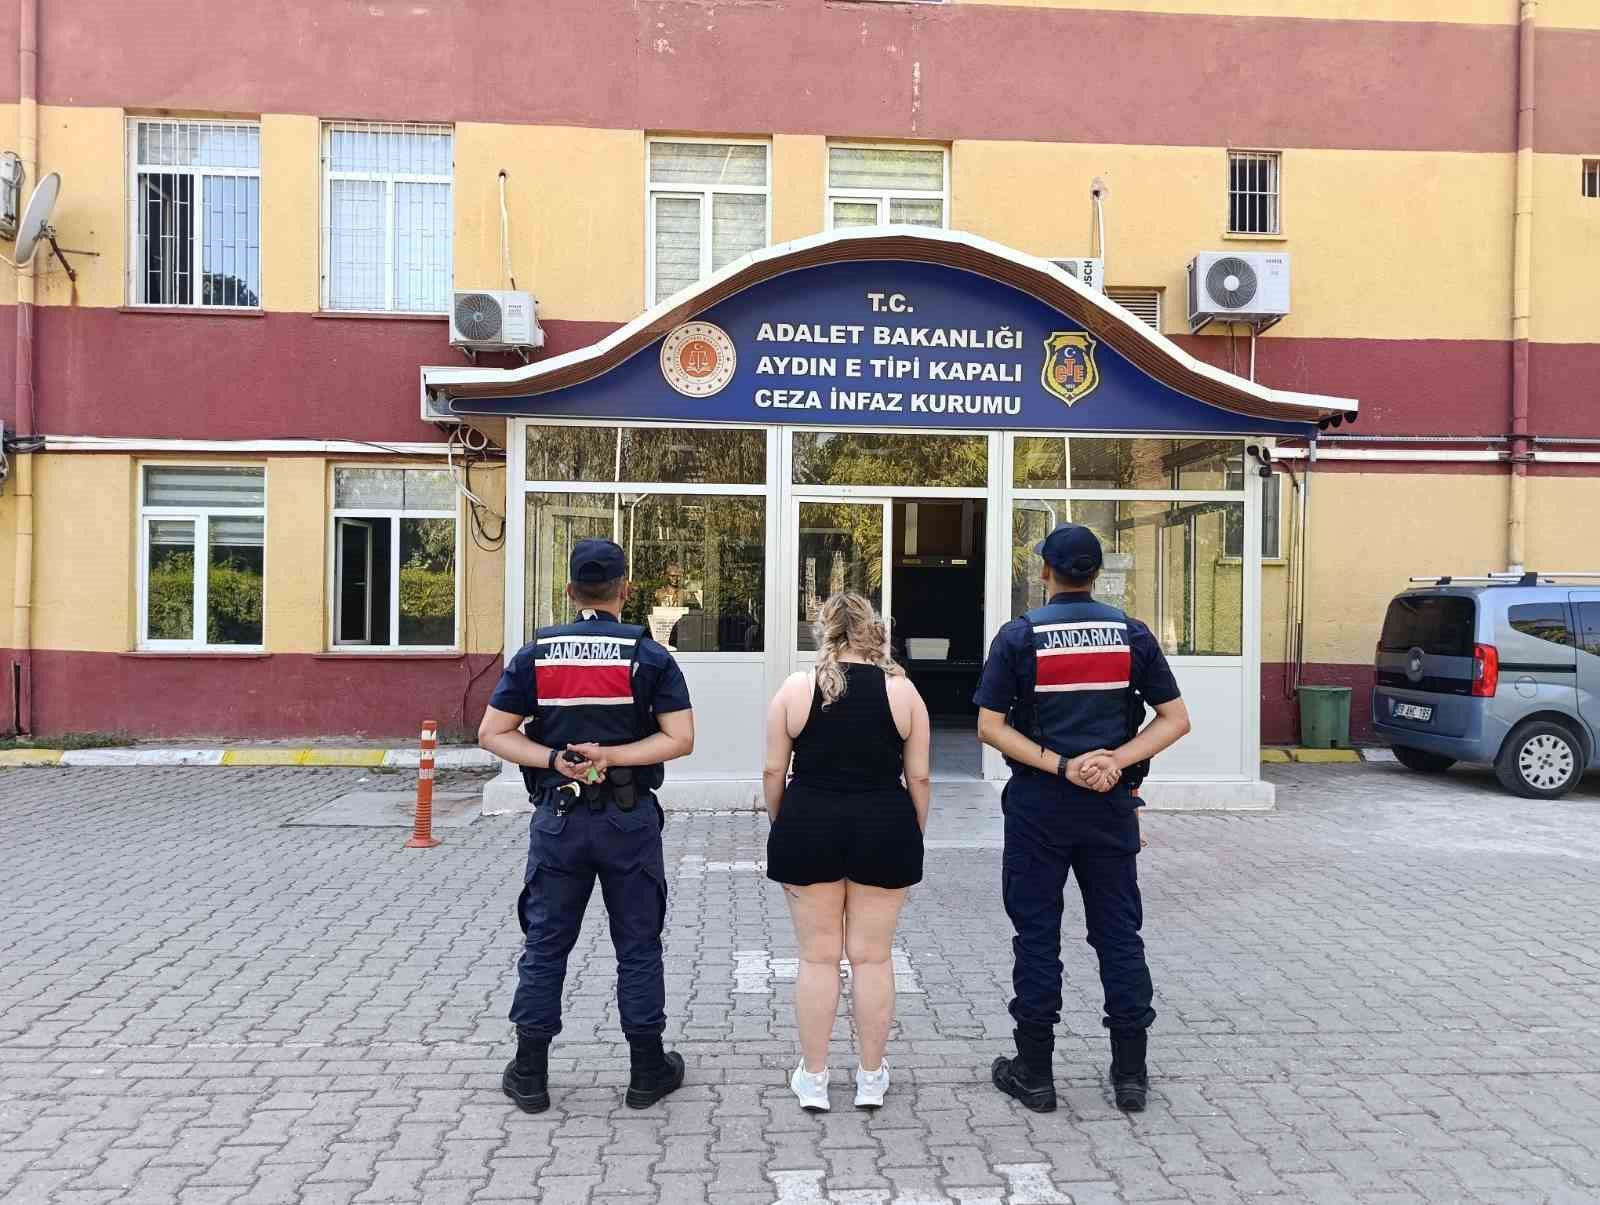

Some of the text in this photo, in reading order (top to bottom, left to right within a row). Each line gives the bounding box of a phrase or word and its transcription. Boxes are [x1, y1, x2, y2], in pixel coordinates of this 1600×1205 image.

[867, 292, 914, 313] T.C.
[756, 322, 1023, 349] ADALET BAKANLIĞI
[755, 355, 1022, 382] AYDIN E TİPİ KAPALI
[754, 386, 1022, 415] CEZA İNFAZ KURUMU
[1044, 628, 1124, 648] JANDARMA
[544, 642, 621, 660] JANDARMA
